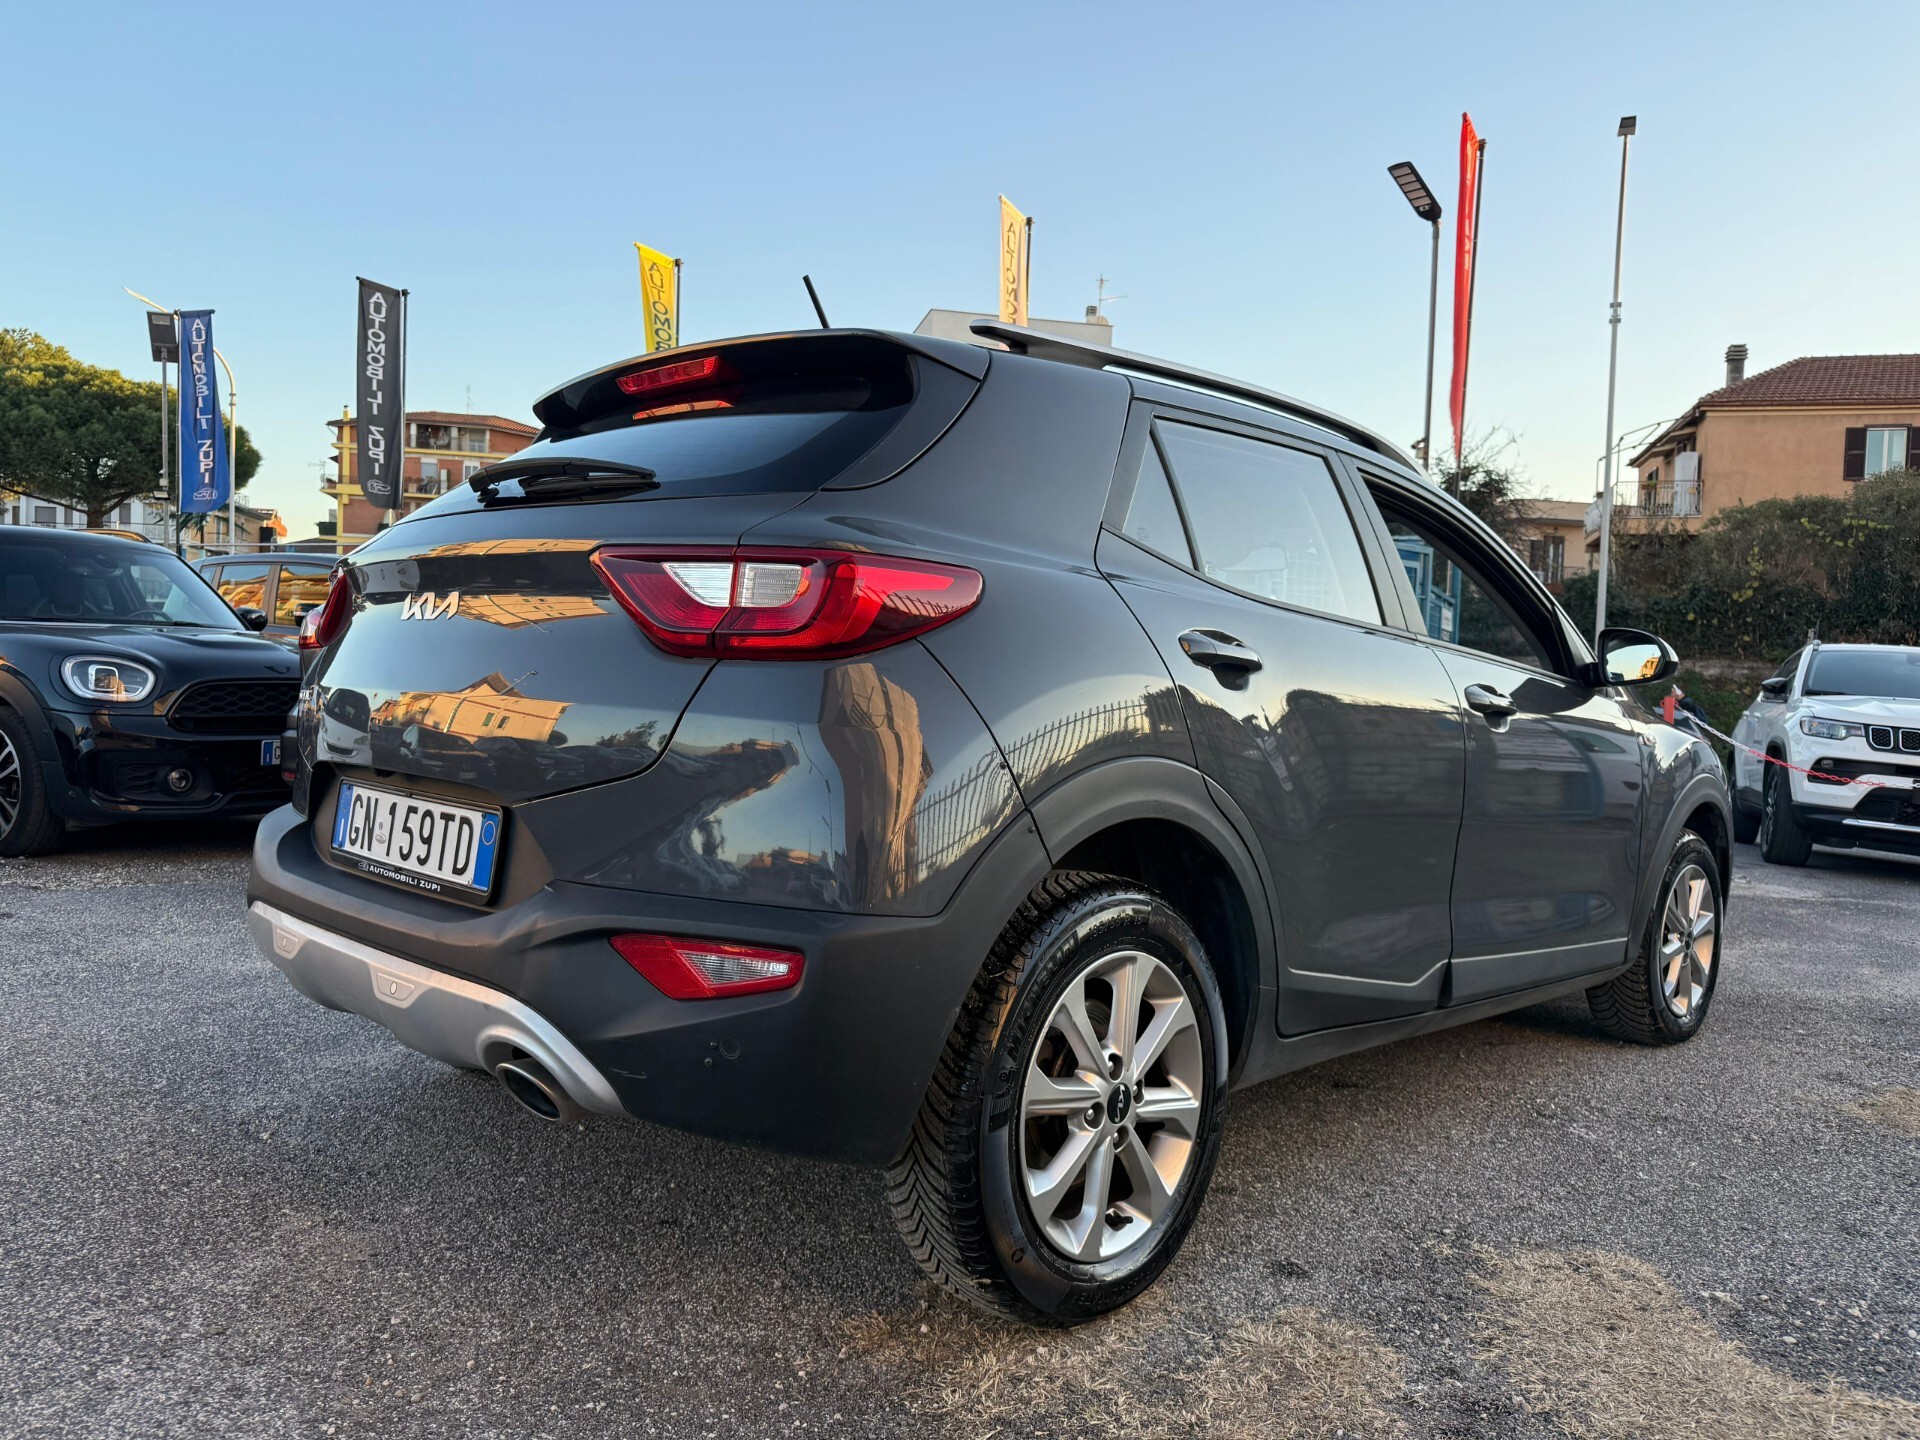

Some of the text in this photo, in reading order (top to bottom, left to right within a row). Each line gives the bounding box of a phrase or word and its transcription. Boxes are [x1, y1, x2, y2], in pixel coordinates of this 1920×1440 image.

[191, 318, 214, 484] AUTOMOBILI ZUPI
[401, 591, 460, 620] KIA
[369, 865, 441, 892] AUTOMOBILI ZUPI
